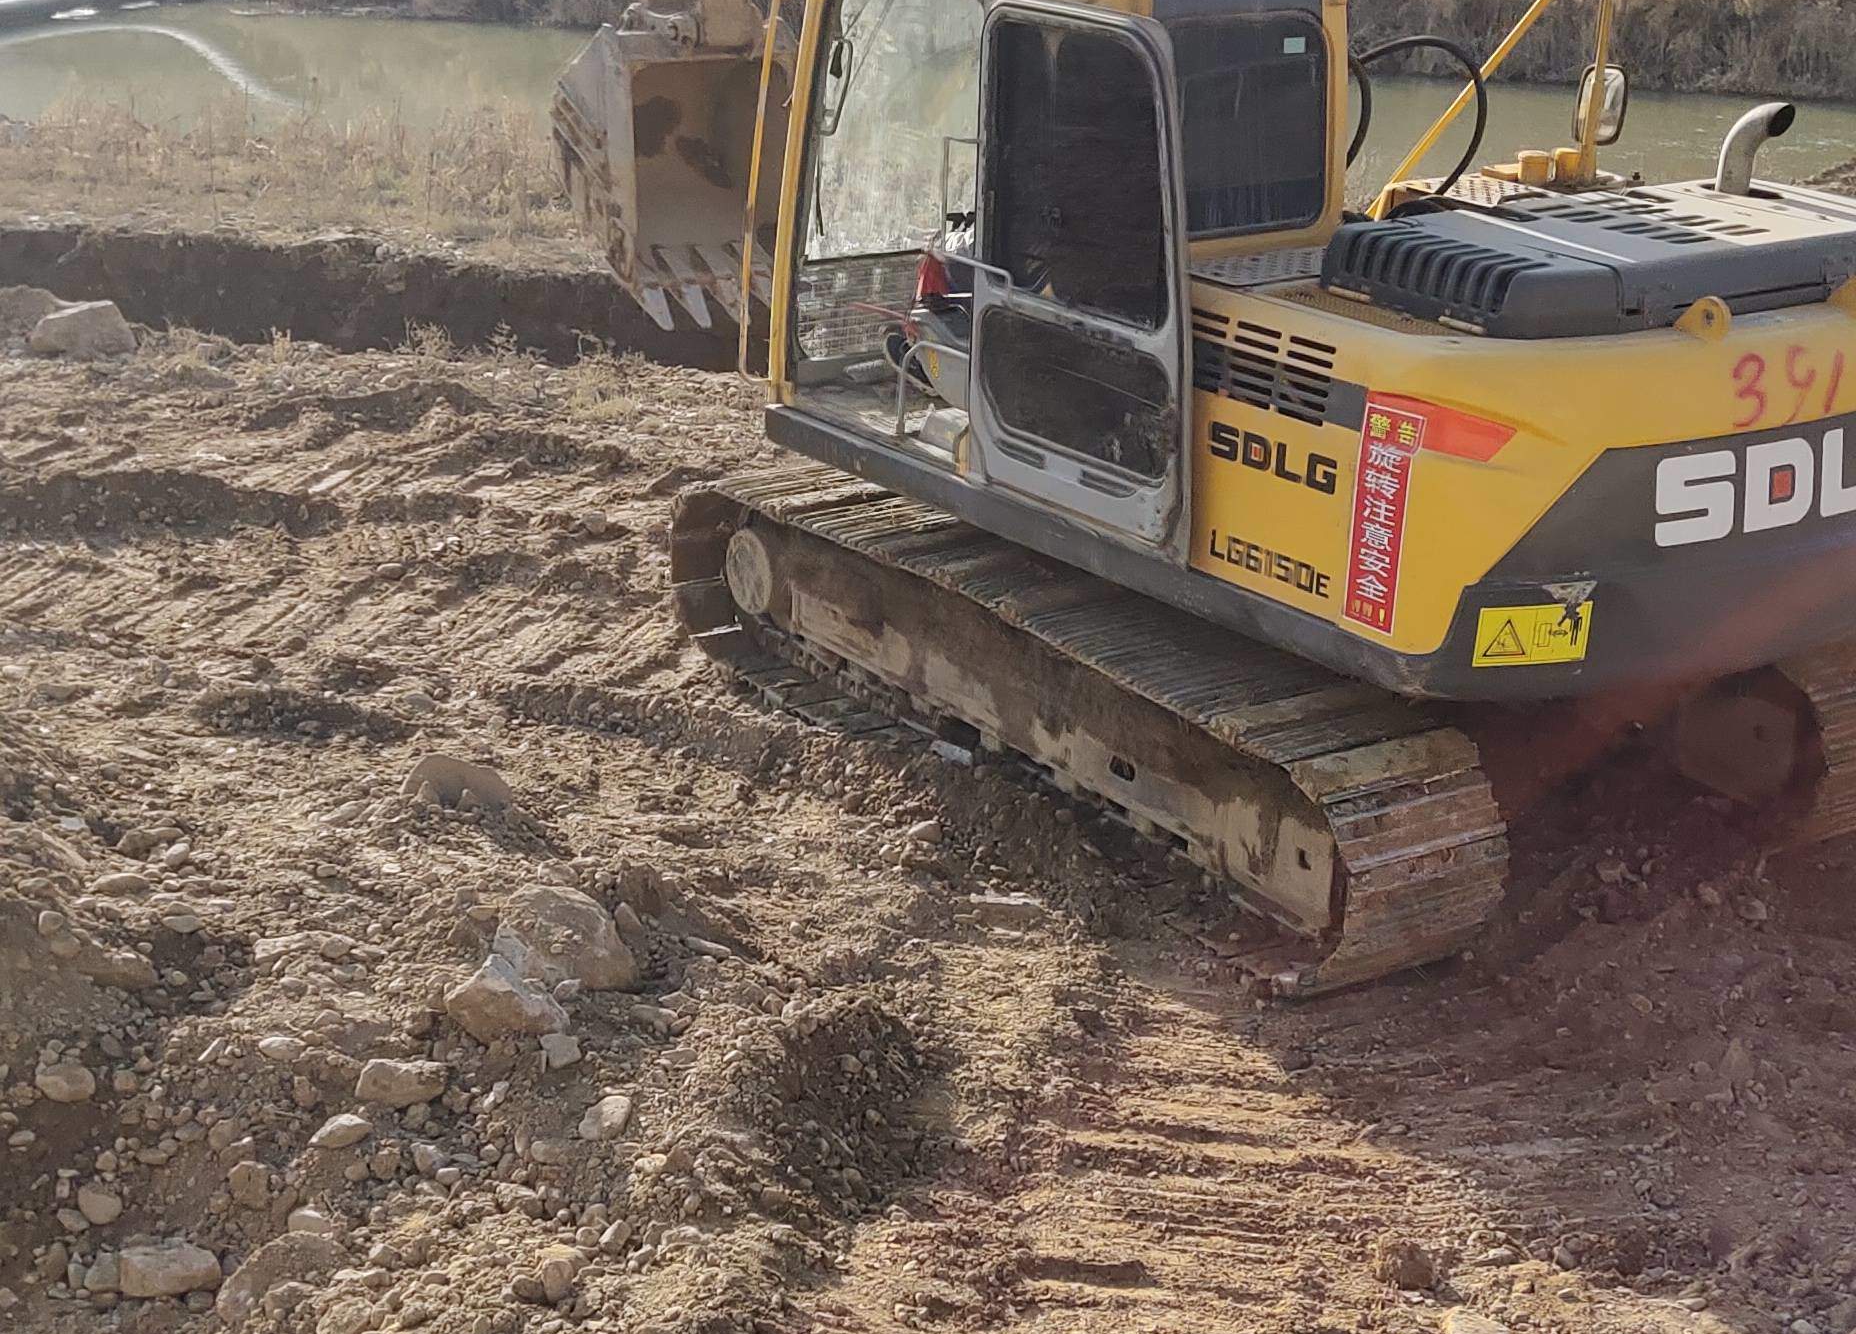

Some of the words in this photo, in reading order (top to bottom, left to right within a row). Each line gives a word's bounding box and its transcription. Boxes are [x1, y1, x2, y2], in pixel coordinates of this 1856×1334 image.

[1210, 421, 1338, 495] SDLG
[1368, 413, 1419, 448] 警告
[1356, 441, 1402, 603] 旋转注意安全
[1209, 529, 1331, 599] LG6150E
